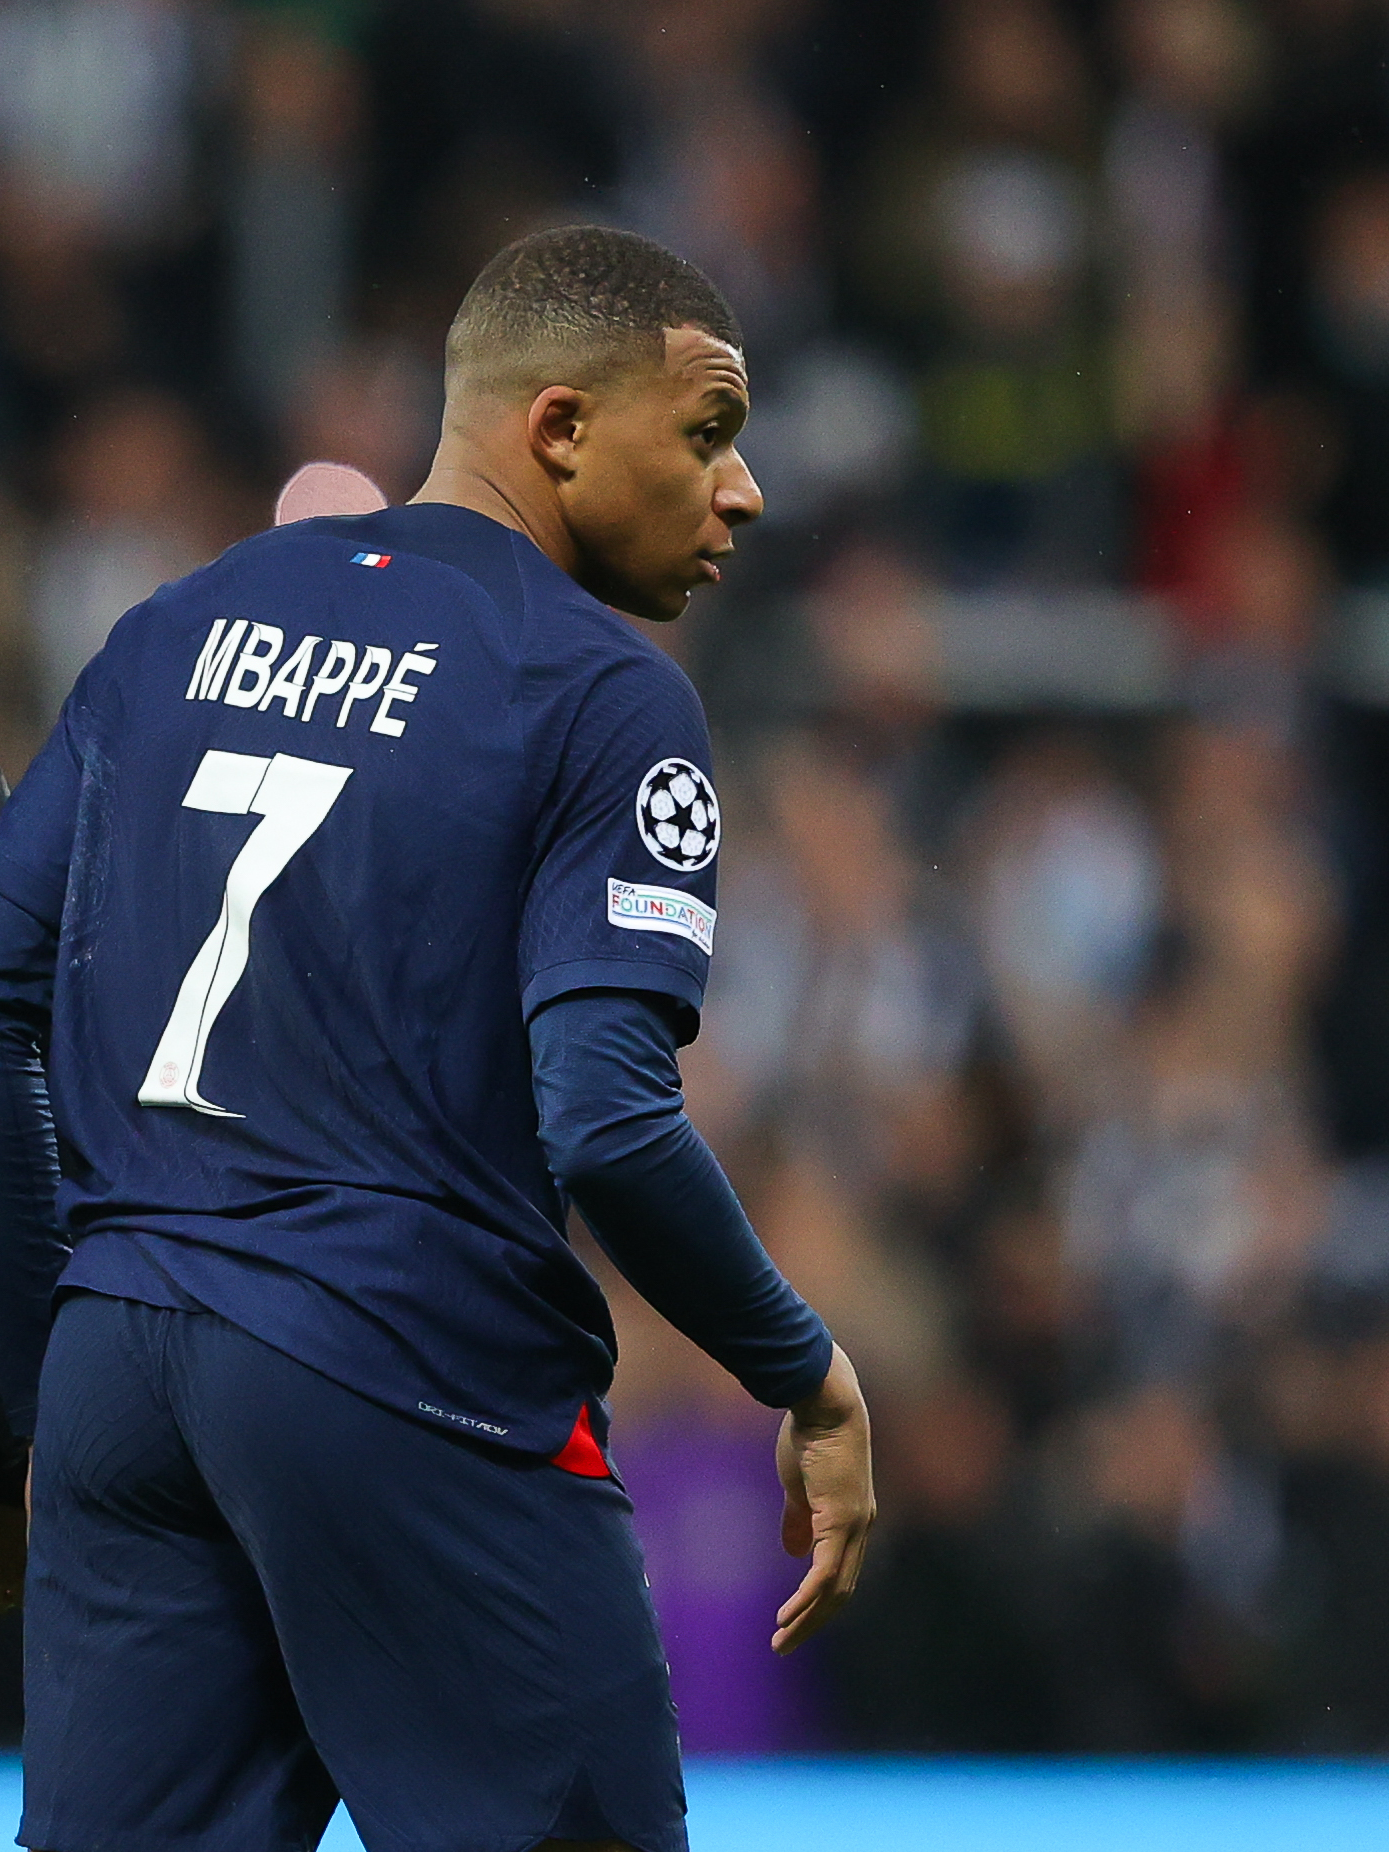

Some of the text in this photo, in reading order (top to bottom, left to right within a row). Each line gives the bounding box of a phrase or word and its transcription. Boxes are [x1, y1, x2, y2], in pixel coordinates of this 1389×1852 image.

[185, 618, 440, 738] MBAPPÉ
[612, 882, 636, 894] UEFA
[612, 894, 711, 939] FOUNDATION
[137, 749, 354, 1118] 7
